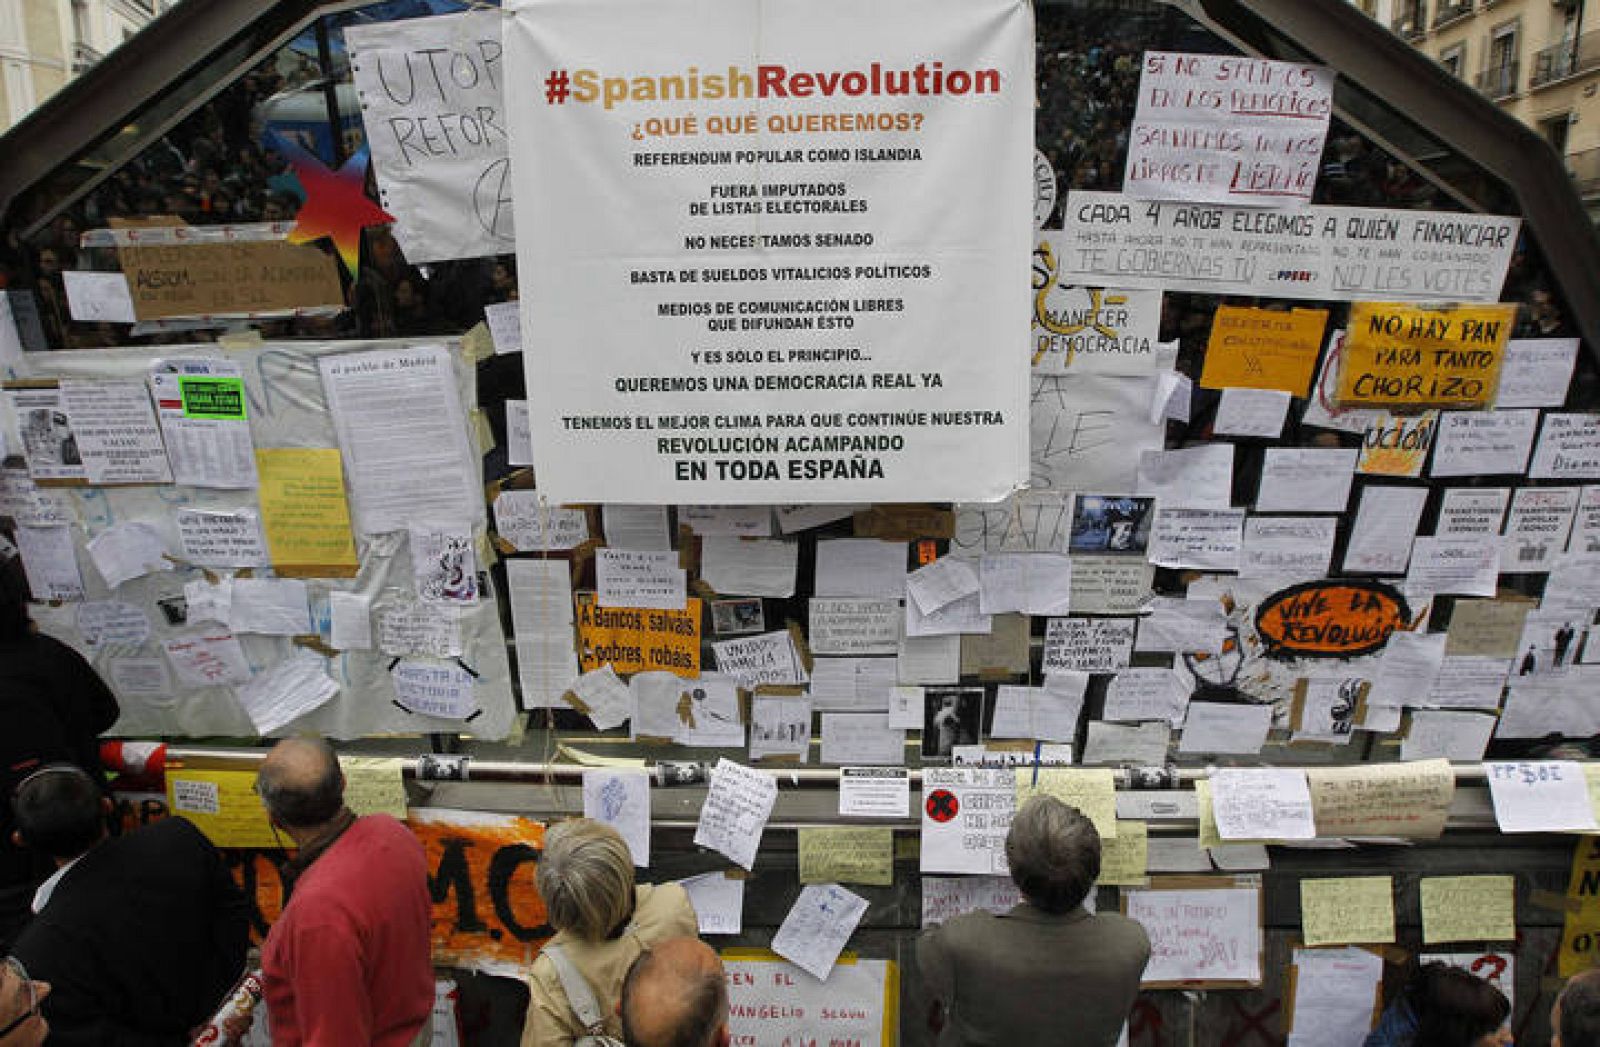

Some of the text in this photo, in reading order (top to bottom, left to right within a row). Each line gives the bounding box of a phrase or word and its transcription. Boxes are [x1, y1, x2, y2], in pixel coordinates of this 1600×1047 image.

[545, 62, 1001, 108] #SpanishRevolution
[632, 113, 697, 140] ¿QUÉ
[767, 112, 925, 134] QUEREMOS?
[634, 151, 732, 167] REFERENDUM
[808, 149, 850, 163] COMO
[854, 148, 923, 162] ISLANDIA
[710, 183, 847, 199] FUERA IMPUTADOS
[690, 200, 868, 216] DE LISTAS ELECTORALES
[1078, 203, 1512, 248] CADA 4 AÑOS ELEGIMOS A QUIÉN FINANCIAR
[684, 236, 706, 250] NO
[815, 233, 874, 248] SENADO
[630, 264, 932, 284] BASTA DE SUELDOS VITALICIOS POLÍTICOS
[1074, 248, 1108, 271] TE
[1116, 248, 1223, 277] GOBERNAS
[1332, 265, 1368, 289] NO
[1373, 266, 1412, 291] LES
[1422, 269, 1494, 293] VOTES
[657, 298, 905, 316] MEDIOS DE COMUNICACIÓN LIBRES
[707, 319, 737, 332] QUE
[741, 318, 814, 331] DIFUNDAN
[1368, 314, 1501, 343] NO HAY PAN
[1036, 334, 1152, 355] DEMOCRACIA
[399, 355, 437, 371] Madrid
[691, 352, 701, 364] Y
[704, 351, 723, 364] ES
[767, 350, 785, 363] EL
[1375, 347, 1422, 366] PARA
[1432, 350, 1494, 369] TANTO
[615, 373, 943, 392] QUEREMOS UNA DEMOCRACIA REAL YA
[562, 416, 632, 430] TENEMOS
[635, 416, 654, 430] EL
[657, 415, 710, 430] MEJOR
[714, 415, 762, 429] CLIMA
[766, 414, 806, 428] PARA
[810, 413, 843, 428] QUE
[930, 410, 1004, 426] NUESTRA
[657, 433, 905, 454] REVOLUCIÓN ACAMPANDO
[675, 454, 885, 481] EN TODA ESPAÑA
